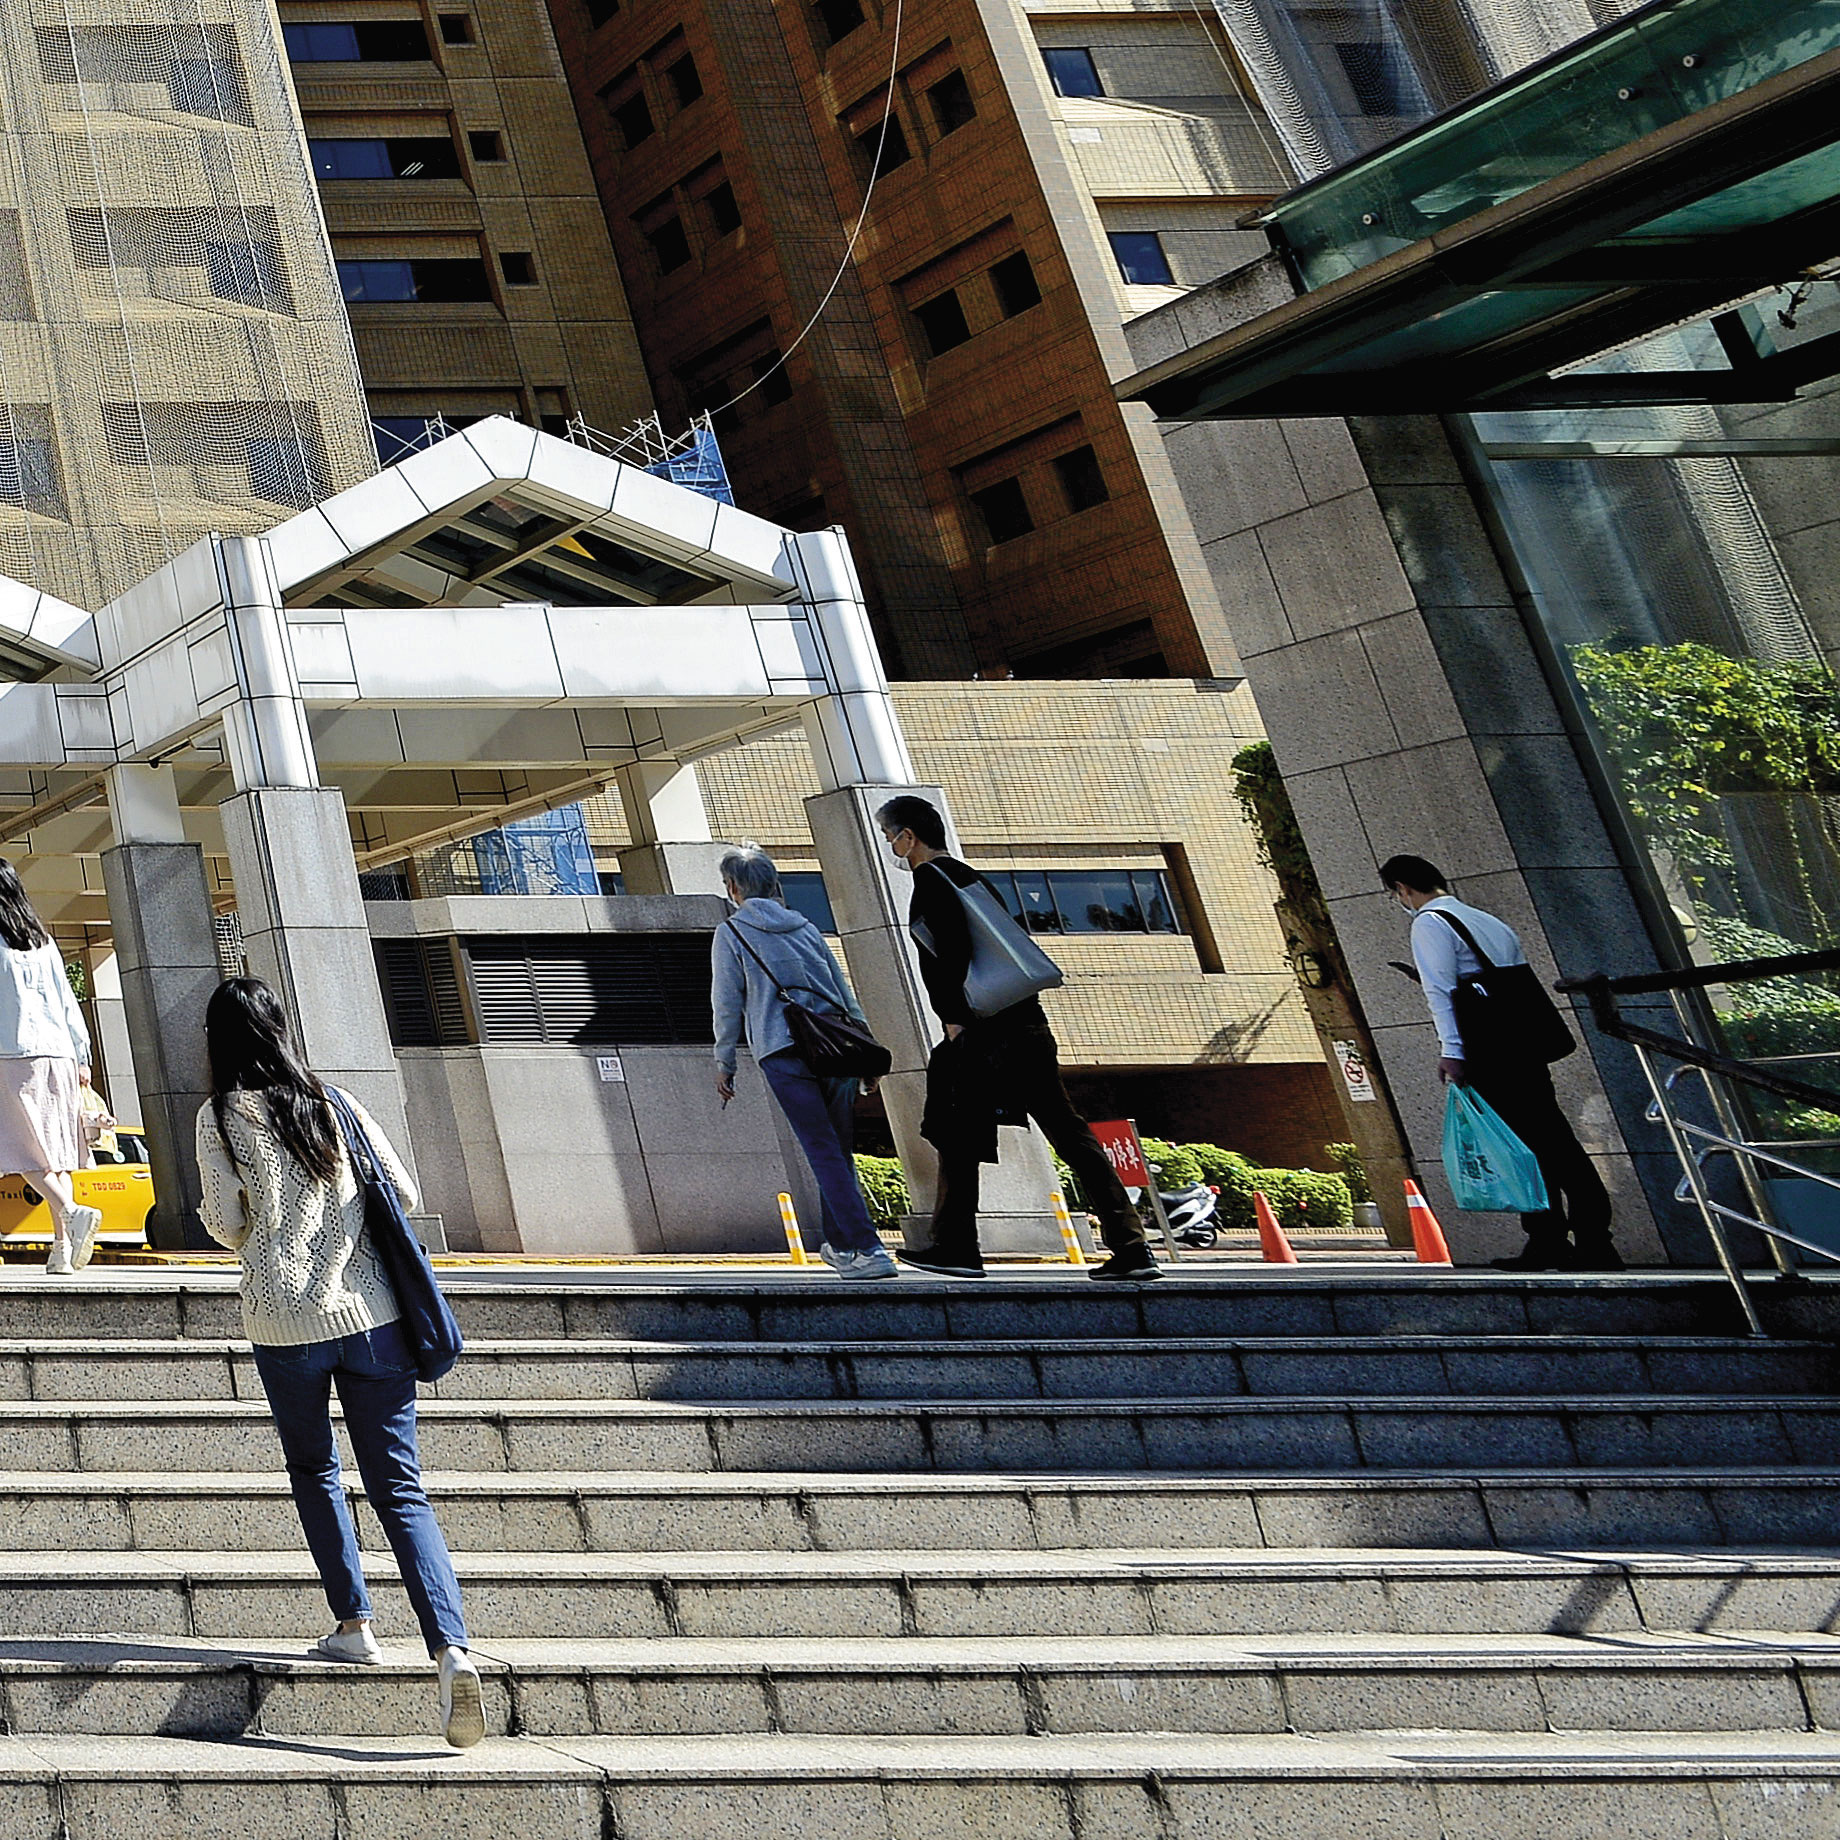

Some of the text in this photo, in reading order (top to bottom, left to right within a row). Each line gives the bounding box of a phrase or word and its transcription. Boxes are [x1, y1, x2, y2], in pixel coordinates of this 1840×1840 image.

[1102, 1137, 1140, 1171] 勿停車
[0, 1190, 23, 1200] Taxi
